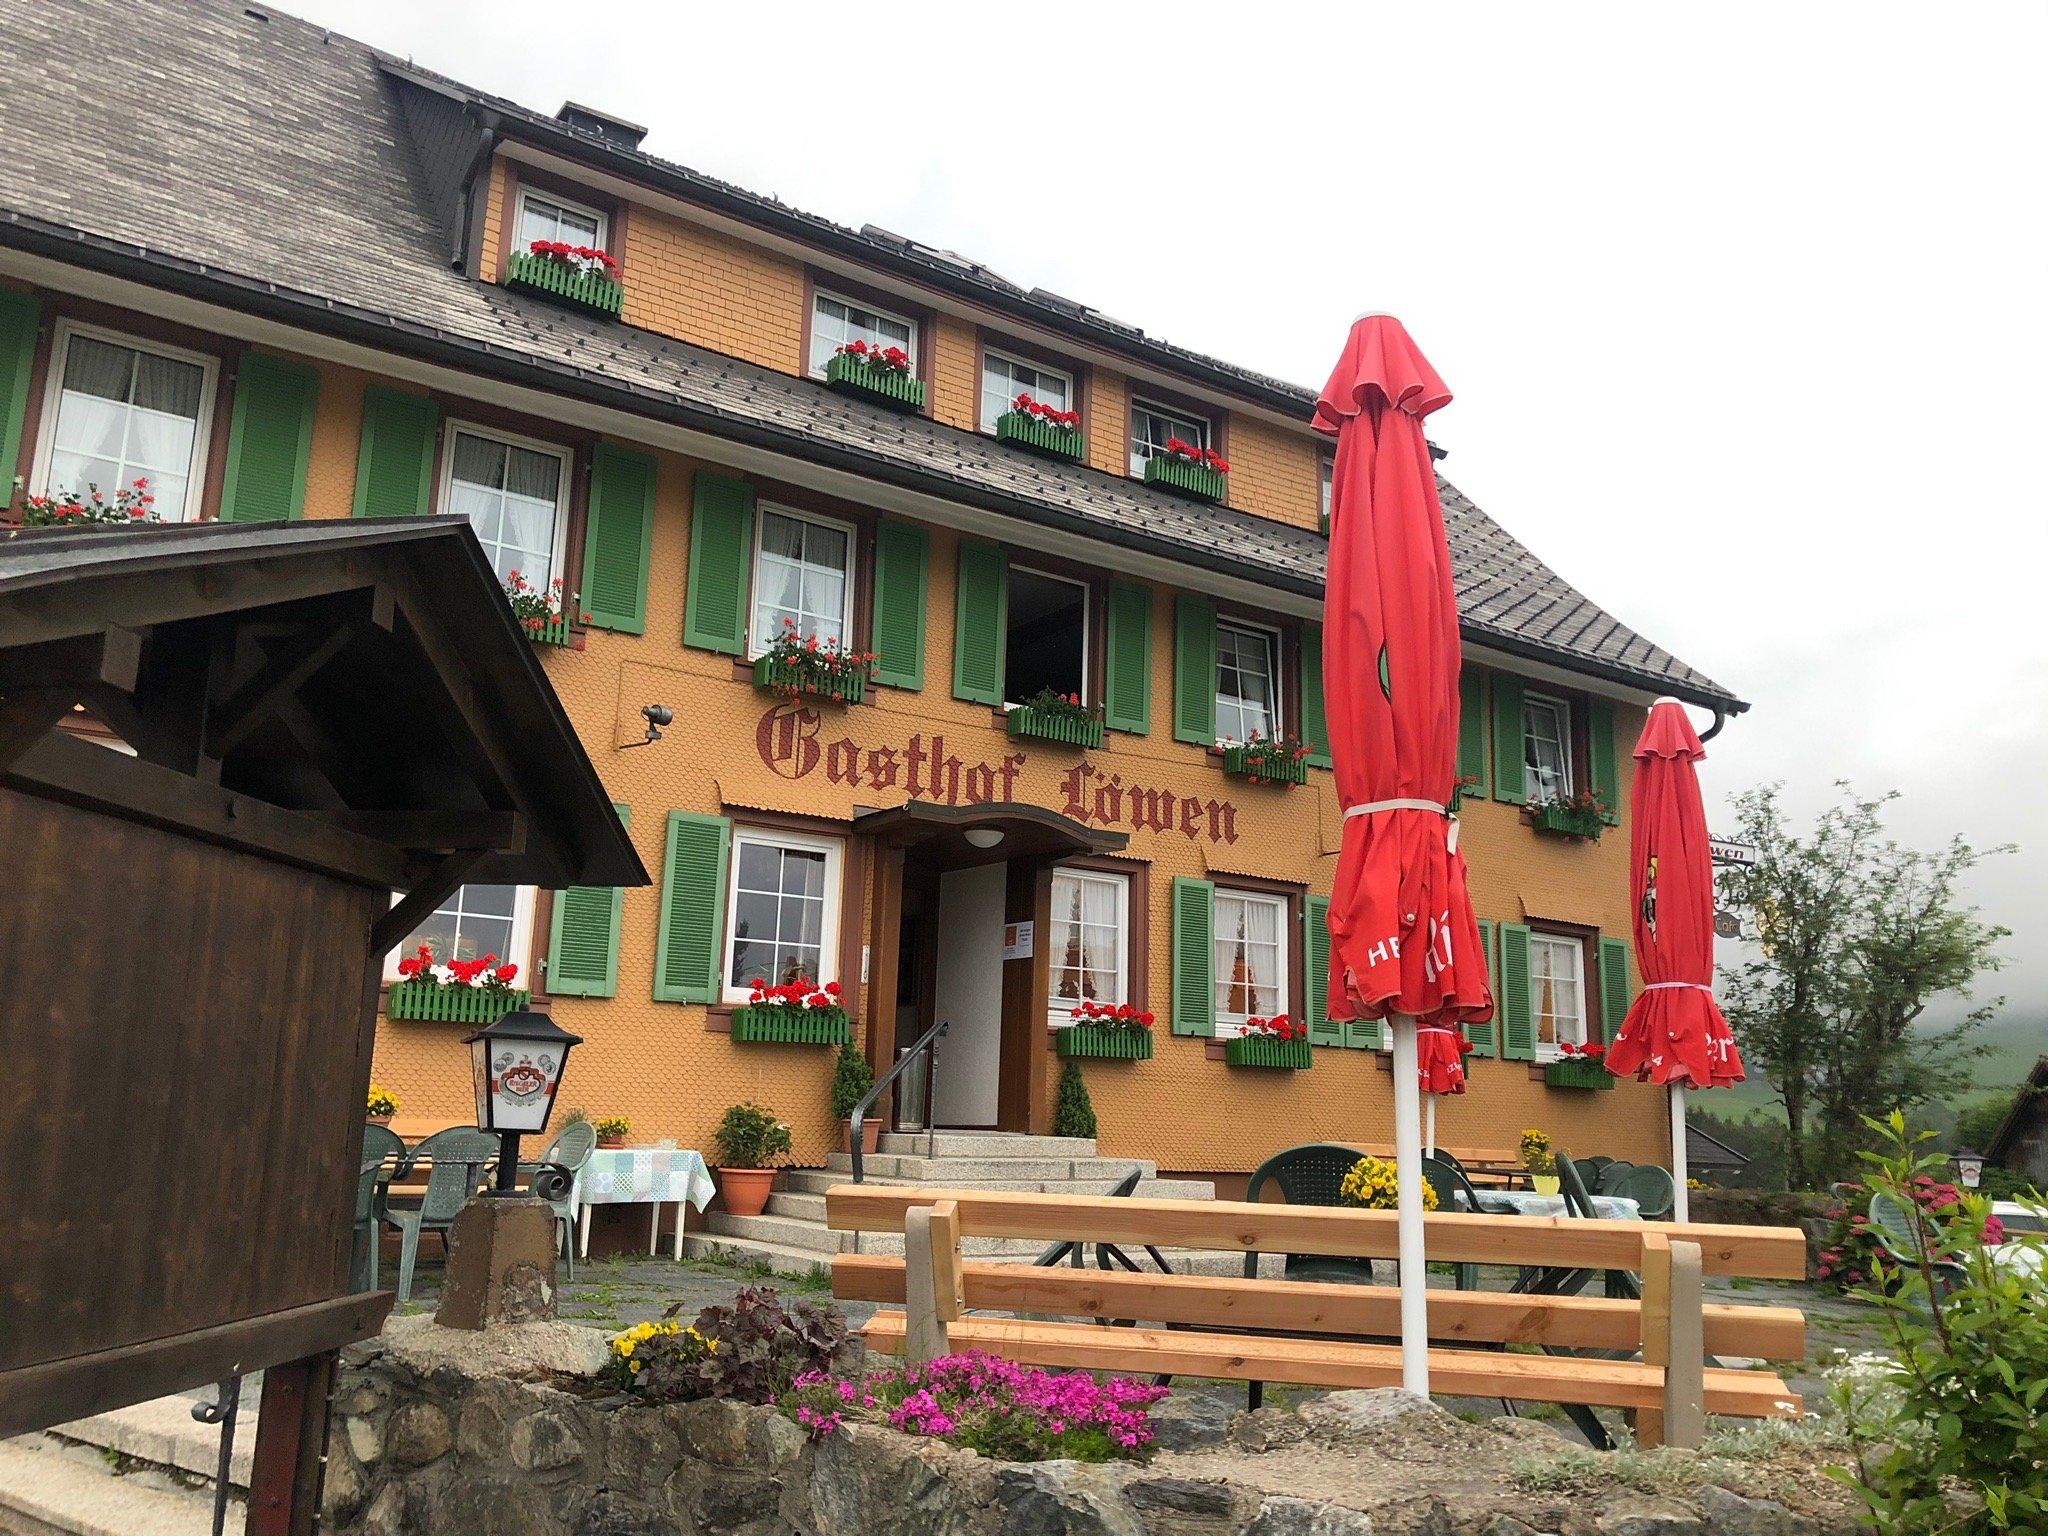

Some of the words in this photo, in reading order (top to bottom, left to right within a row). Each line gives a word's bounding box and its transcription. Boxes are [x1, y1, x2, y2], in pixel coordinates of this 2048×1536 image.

[756, 704, 1027, 806] Gasthof
[1060, 761, 1240, 846] Löwen
[1709, 846, 1745, 860] wen
